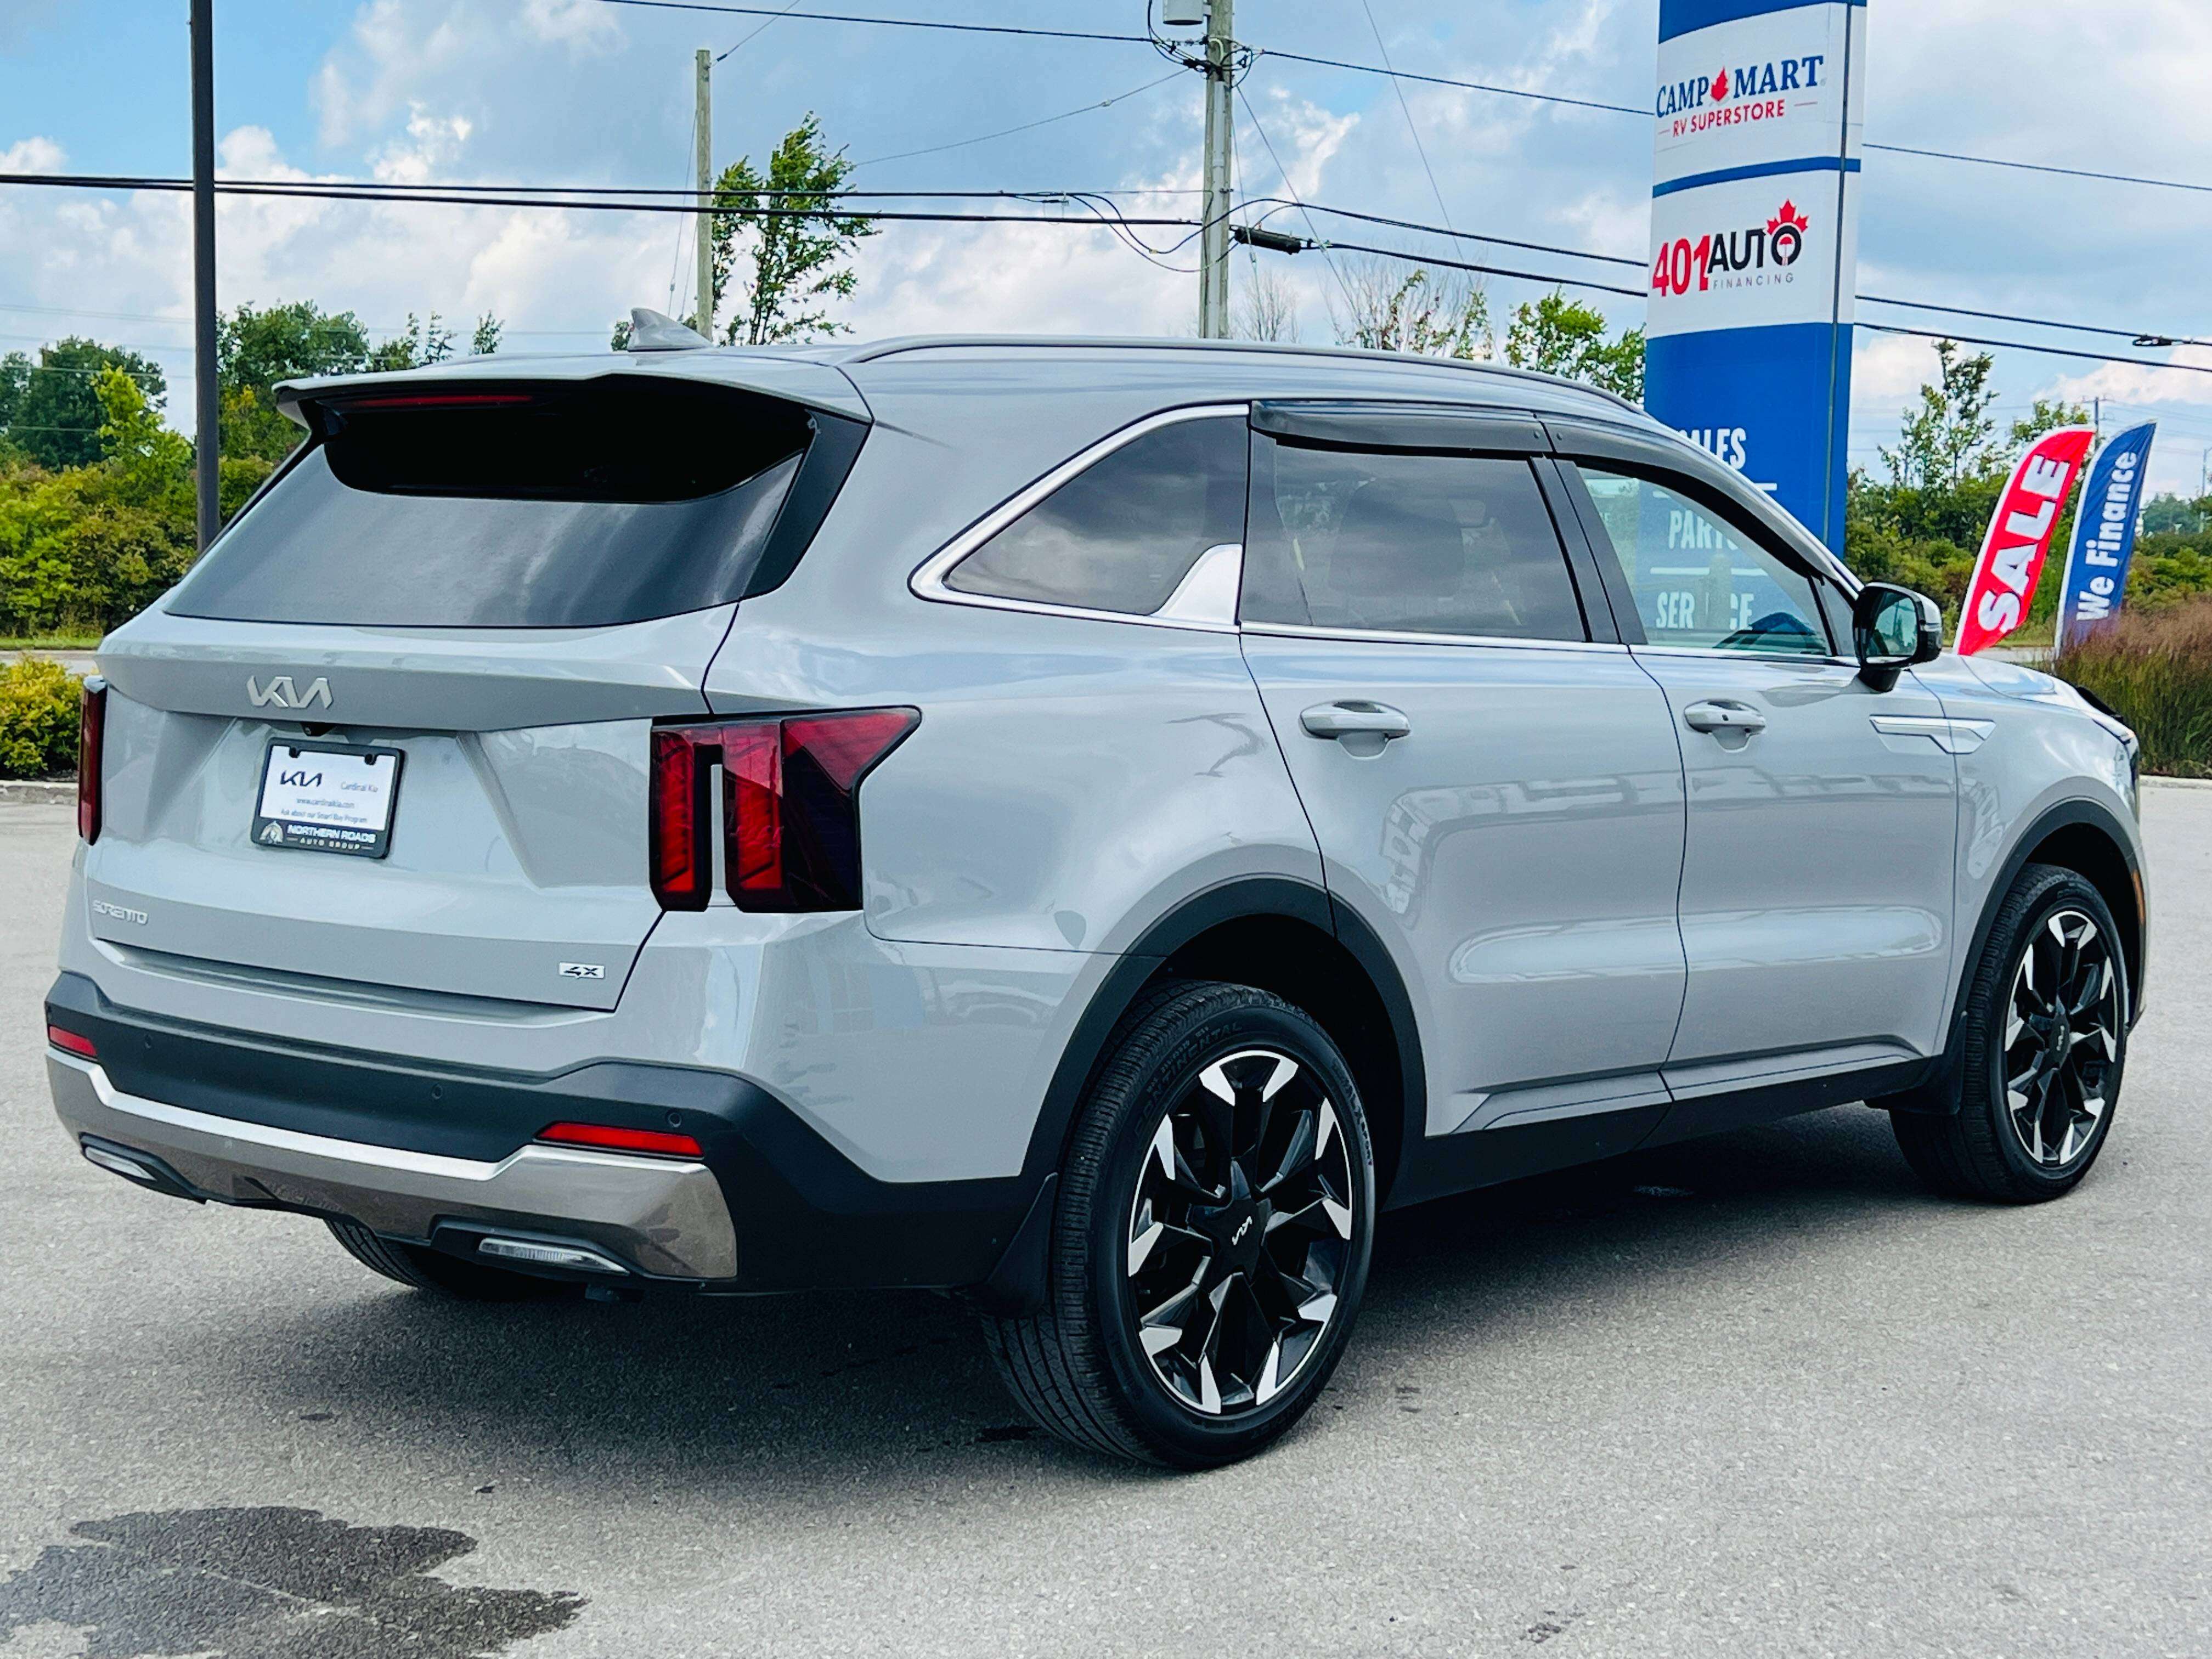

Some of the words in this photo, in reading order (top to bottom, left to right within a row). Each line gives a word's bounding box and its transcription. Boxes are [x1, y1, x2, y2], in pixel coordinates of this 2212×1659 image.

[1657, 76, 1709, 118] CAMP
[1734, 55, 1824, 99] MART
[1673, 120, 1688, 137] RV
[1691, 99, 1785, 133] SUPERSTORE
[1713, 273, 1794, 290] FINANCING
[2086, 451, 2137, 568] Finance
[1977, 454, 2070, 634] SALE
[2076, 575, 2115, 621] We
[247, 675, 334, 709] KIA
[280, 770, 323, 787] KIA
[287, 824, 341, 839] NORTHERN
[341, 830, 376, 843] ROADS
[300, 837, 325, 846] AUTO
[329, 840, 360, 850] GROUP
